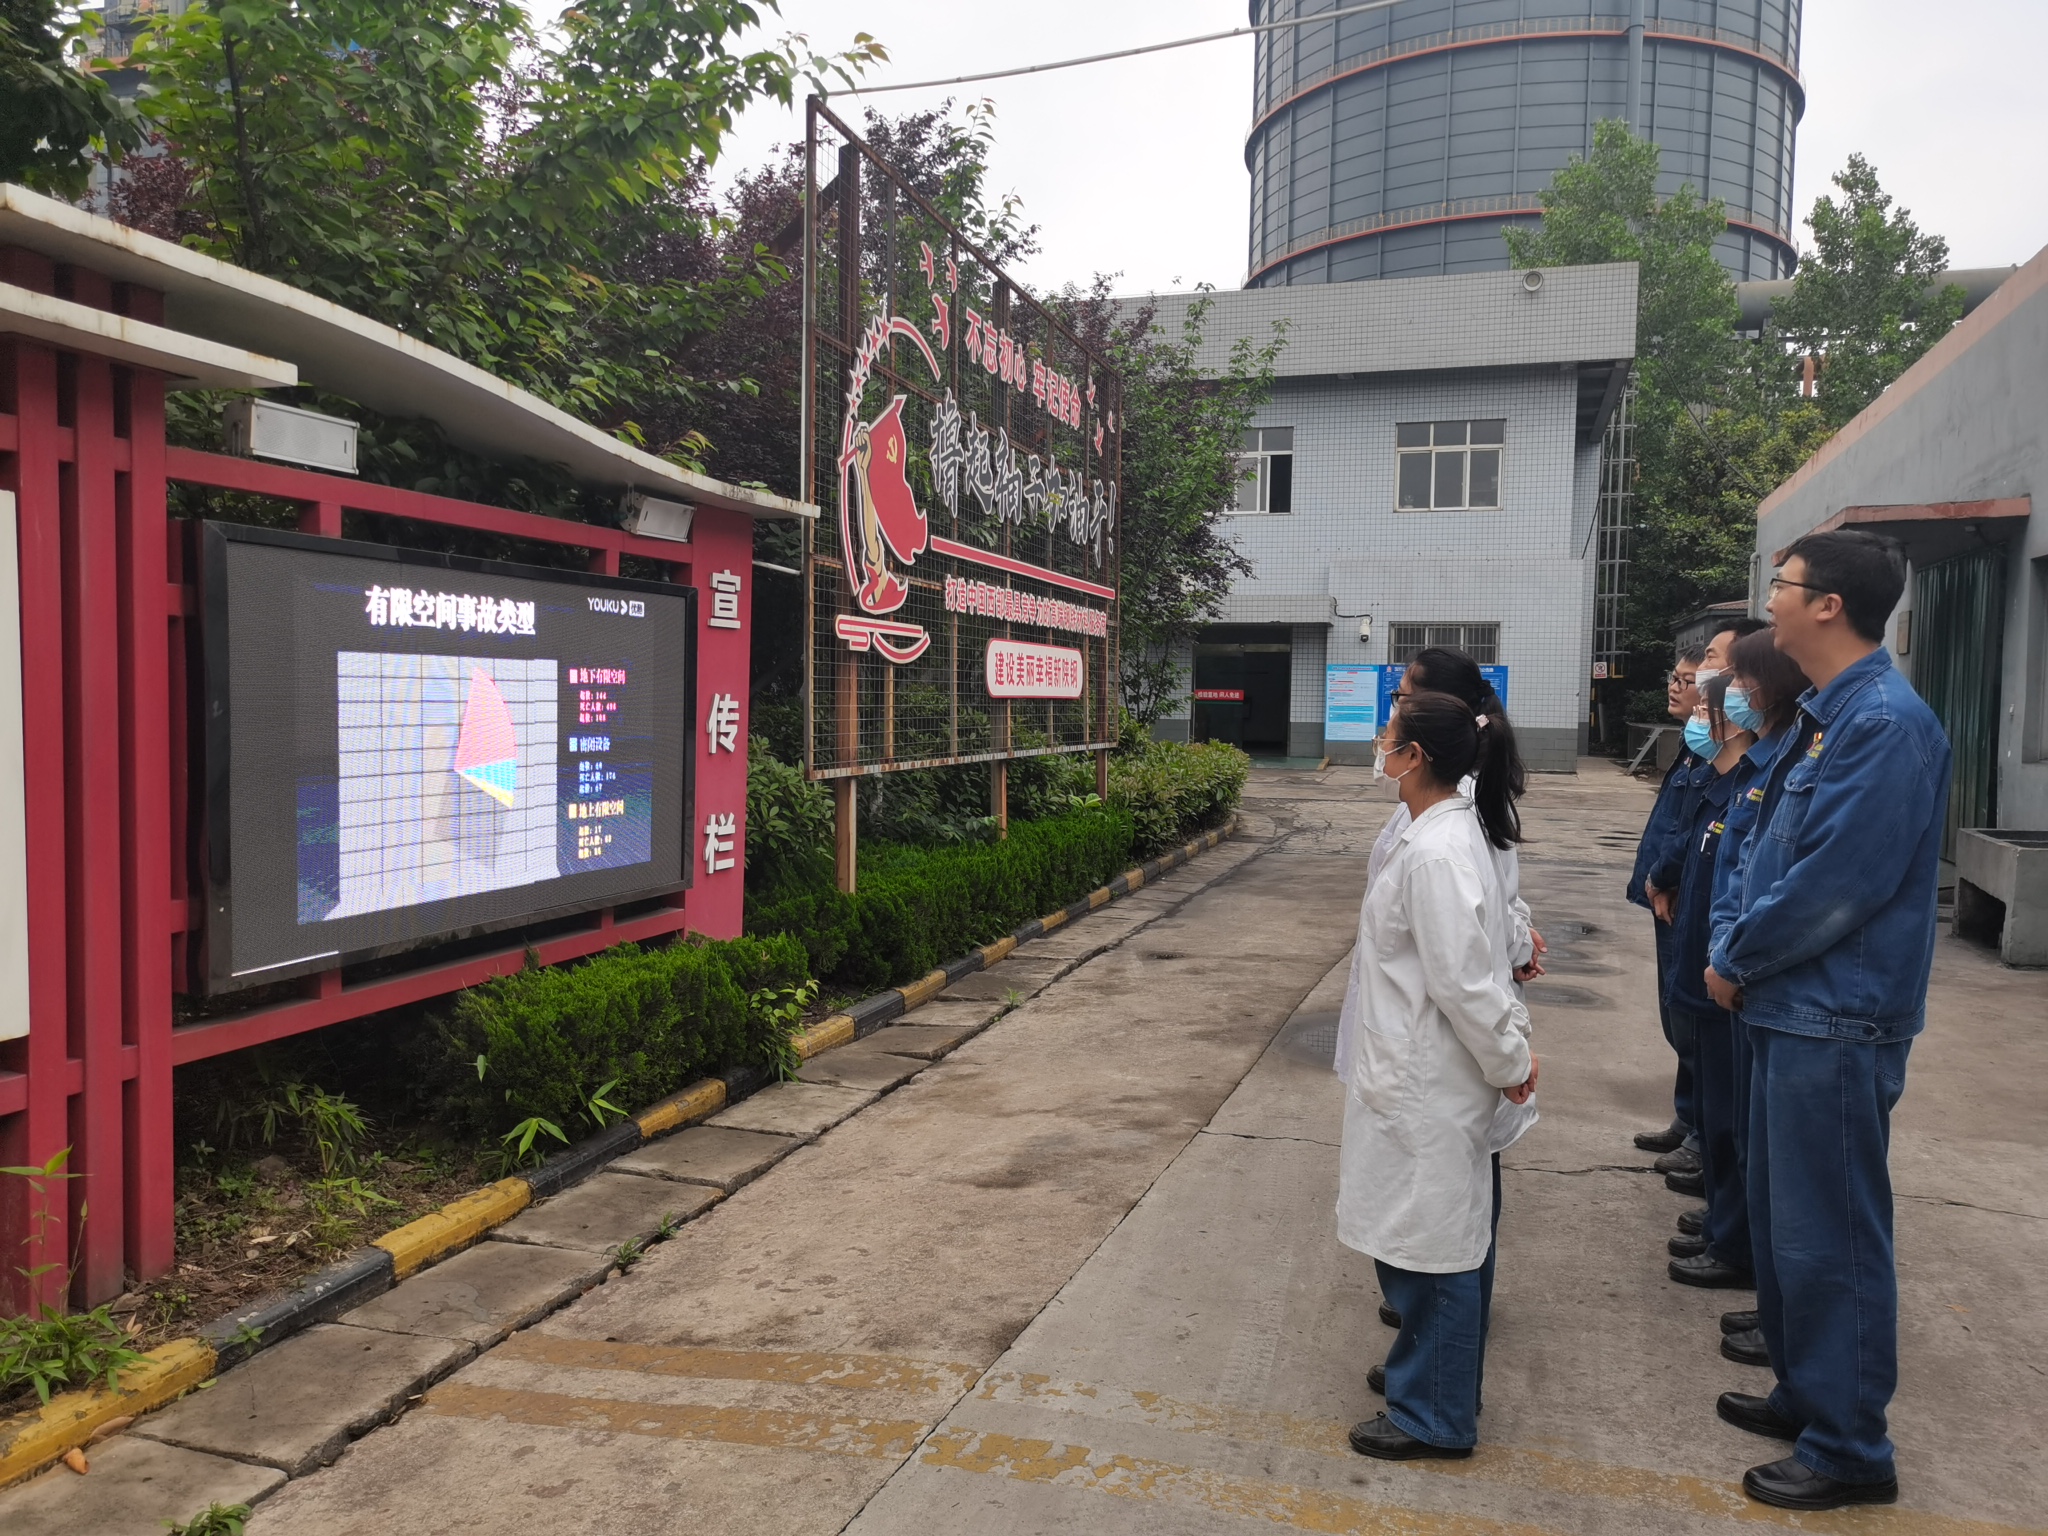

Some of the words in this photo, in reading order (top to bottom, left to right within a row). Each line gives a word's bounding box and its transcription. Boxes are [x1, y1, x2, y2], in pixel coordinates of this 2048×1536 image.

[964, 306, 1027, 393] 不忘初心
[1032, 357, 1082, 430] 牢记使命
[365, 584, 537, 635] 有限空间事故类型
[587, 597, 620, 614] YOUKU
[580, 668, 626, 685] 地下有限空间
[994, 651, 1078, 689] 建设美丽幸福新陕钢
[703, 569, 741, 875] 宣传栏
[579, 799, 625, 819] 地上有限空间
